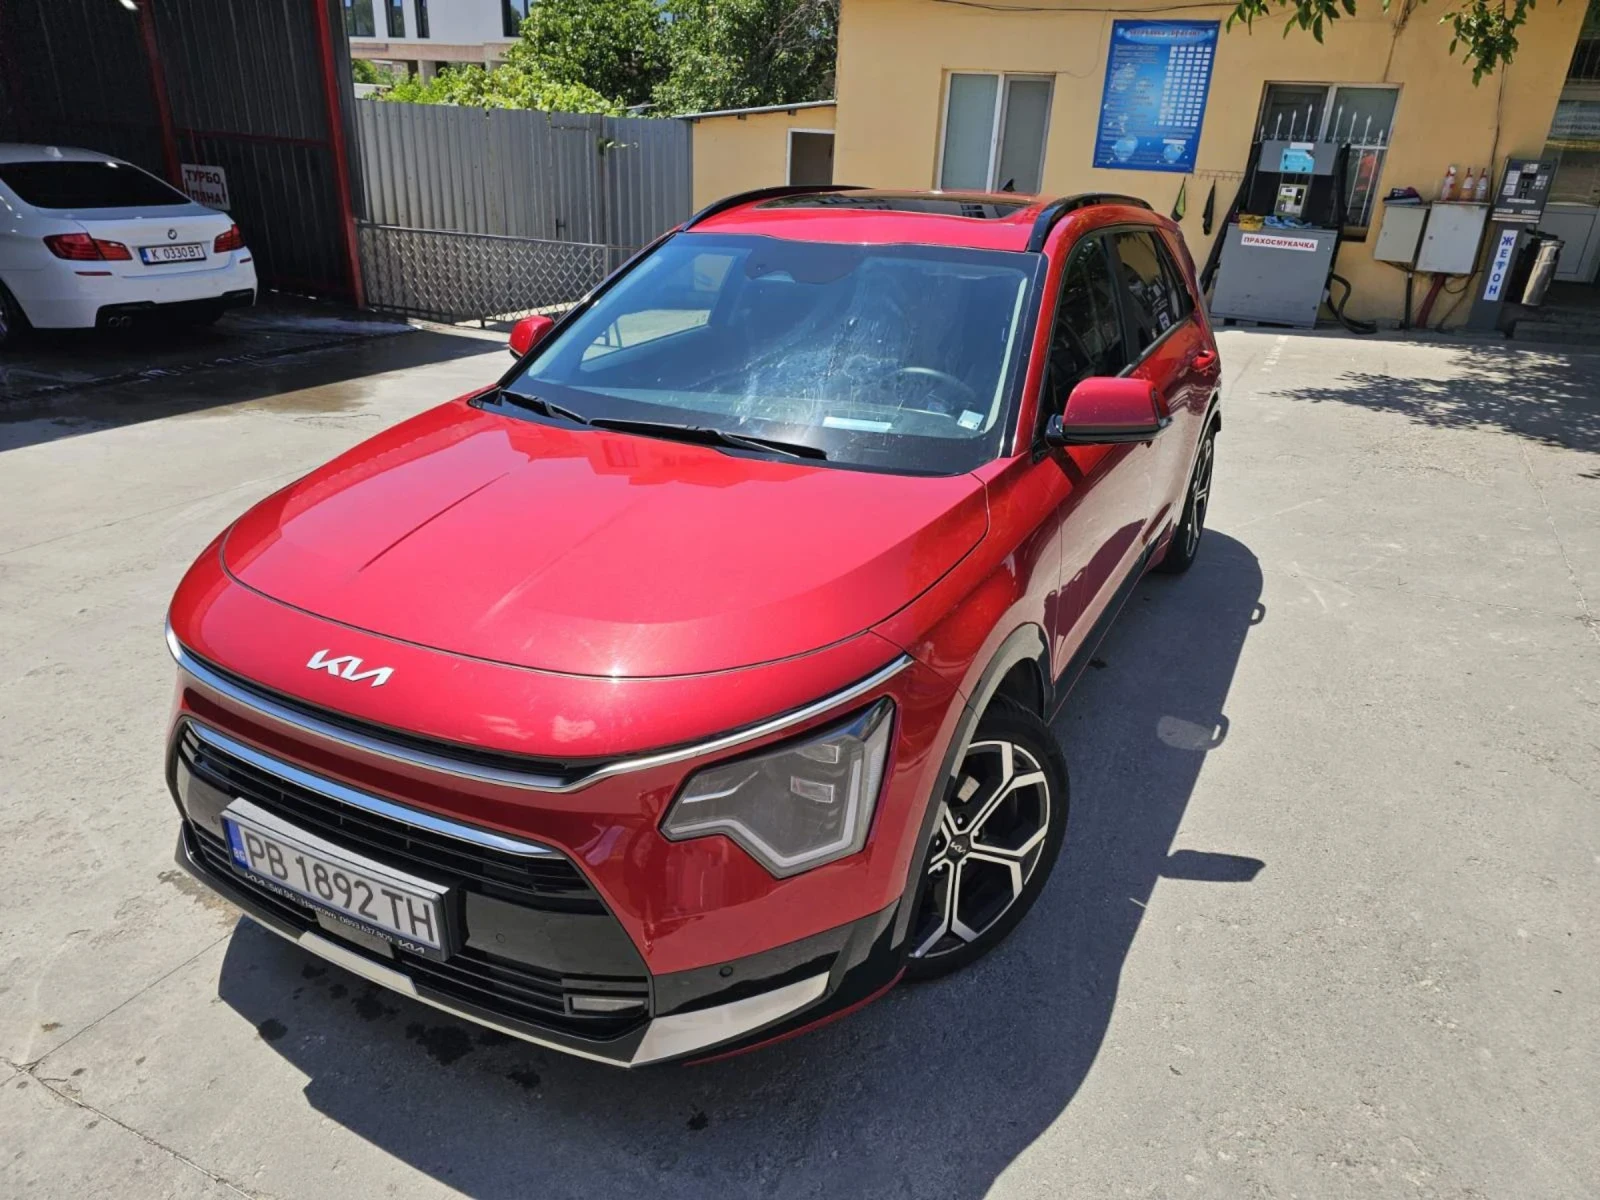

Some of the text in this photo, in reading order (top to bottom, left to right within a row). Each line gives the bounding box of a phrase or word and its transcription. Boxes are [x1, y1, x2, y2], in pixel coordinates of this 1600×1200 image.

[185, 170, 221, 184] ТУРБО
[191, 190, 222, 204] ПЯНА
[1243, 236, 1316, 249] ПРАХОСМУКАЧКА
[1488, 236, 1514, 295] ЖЕТОН
